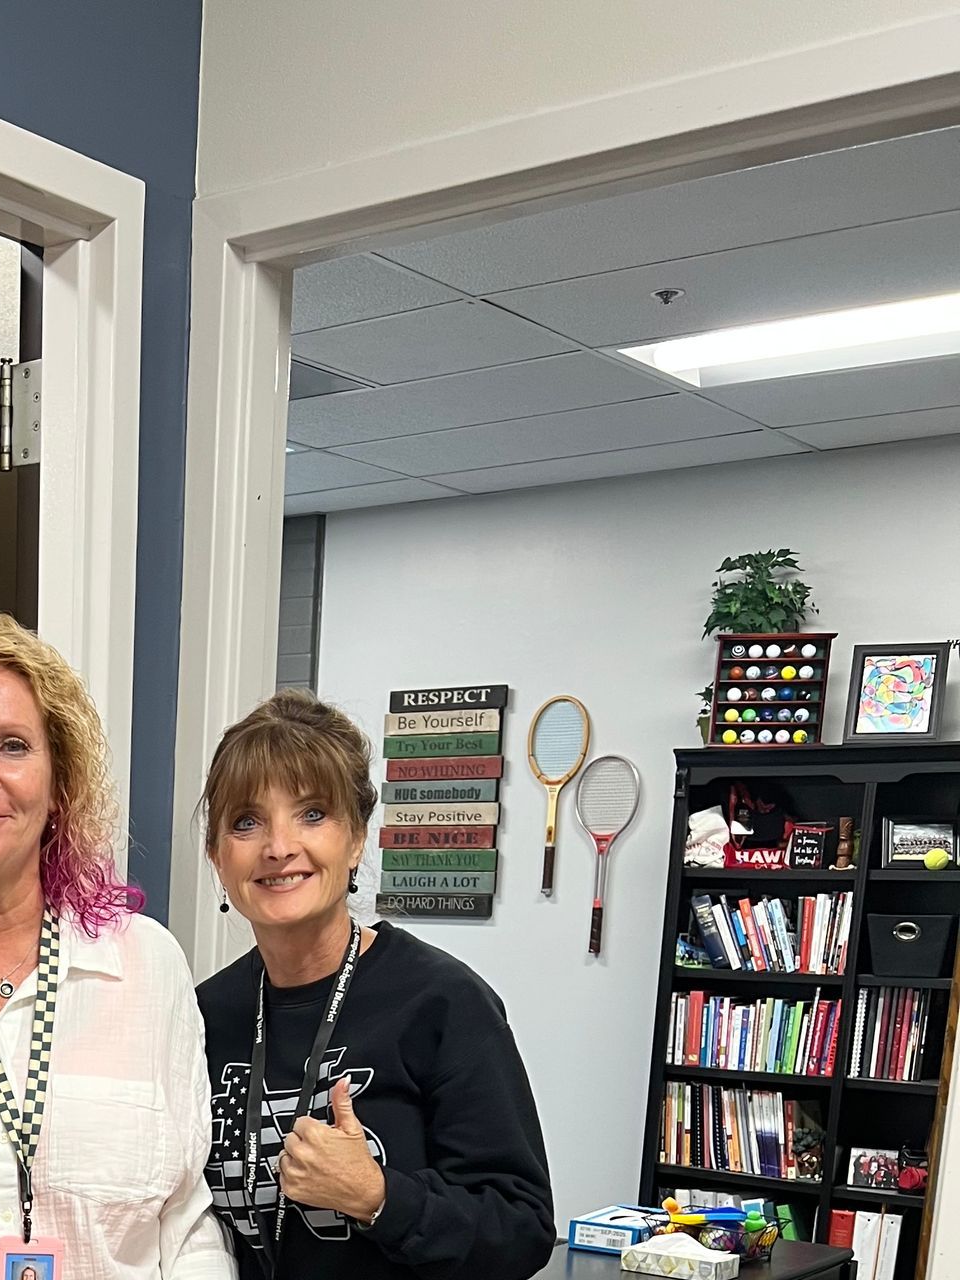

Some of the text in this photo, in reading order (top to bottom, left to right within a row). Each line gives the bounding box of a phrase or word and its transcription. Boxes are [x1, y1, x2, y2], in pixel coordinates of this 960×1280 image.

[402, 688, 491, 706] RESPECT
[398, 711, 486, 730] Be Yourself
[395, 738, 484, 753] Try Your Best
[398, 764, 486, 778] NO WHINING
[394, 787, 481, 800] HUG somebody
[395, 811, 482, 824] Stay Positive
[392, 832, 479, 845] BE NICE
[391, 853, 480, 866] SAY THANK YOU
[392, 876, 480, 888] LAUGH A LOT
[387, 896, 475, 910] DO HARD THINGS
[336, 963, 354, 991] School
[326, 991, 345, 1022] District
[247, 1132, 257, 1163] District
